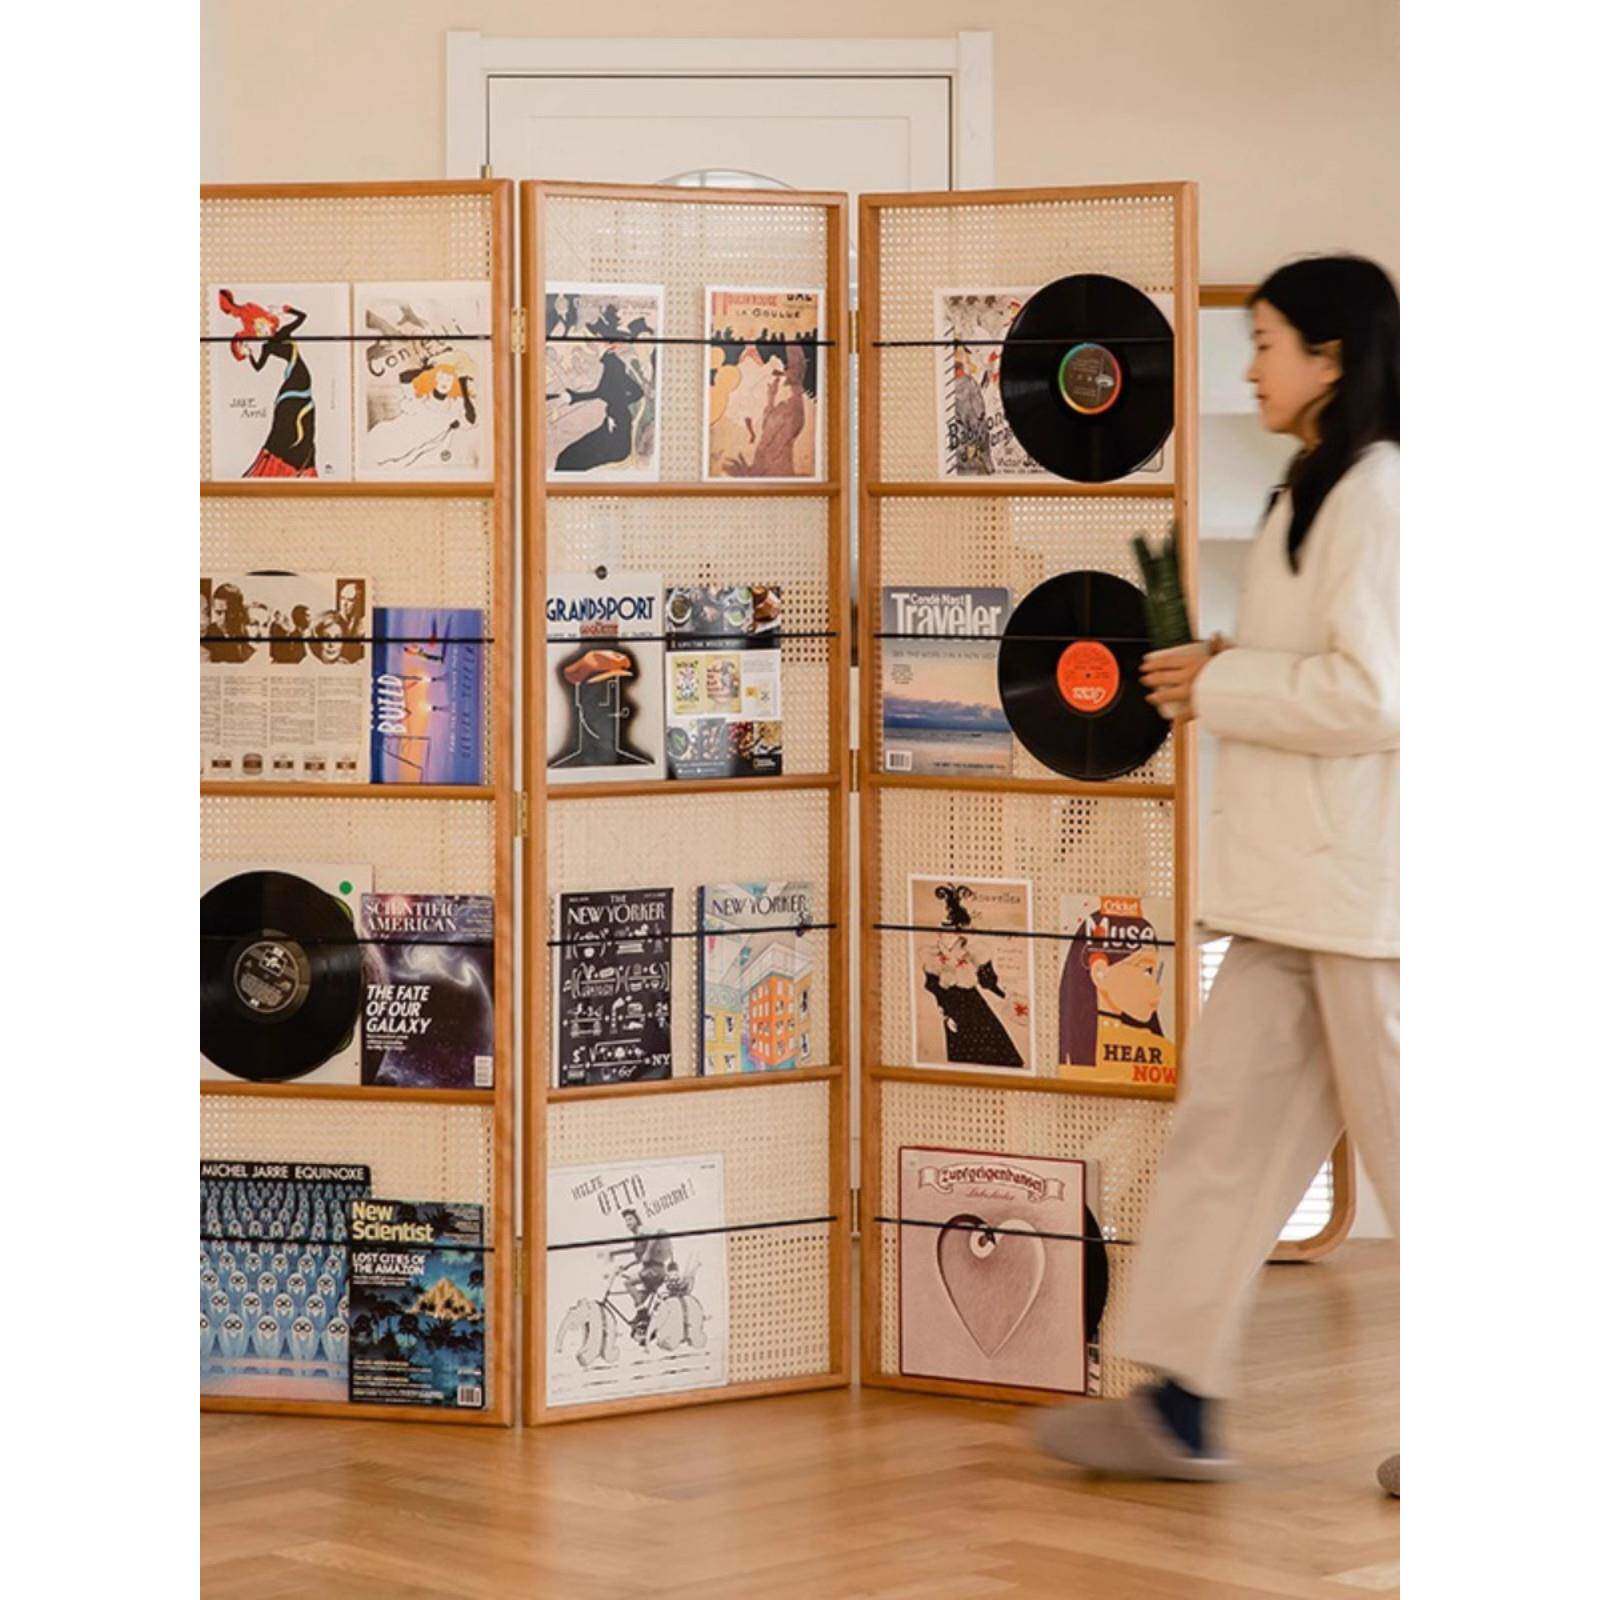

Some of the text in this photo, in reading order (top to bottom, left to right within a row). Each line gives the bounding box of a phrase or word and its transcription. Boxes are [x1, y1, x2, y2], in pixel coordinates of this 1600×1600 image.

[891, 593, 1001, 642] Traveler
[377, 674, 408, 733] BUILD
[567, 902, 665, 926] NEW YORKER
[712, 894, 808, 916] NEW YORKER
[367, 917, 457, 932] AMERICAN
[366, 985, 432, 1002] THE FATE
[365, 1001, 422, 1017] OF OUR
[366, 1017, 433, 1035] GALAXY
[1103, 1044, 1162, 1065] HEAR
[1132, 1065, 1177, 1085] NOW
[201, 1163, 365, 1181] MICHEL JARRE EQUINOXE
[597, 1173, 647, 1217] OTTO
[352, 1201, 393, 1221] New
[352, 1219, 434, 1243] Scientist
[352, 1251, 425, 1266] LOST CITIES OF
[353, 1263, 425, 1277] THE AMAZON
